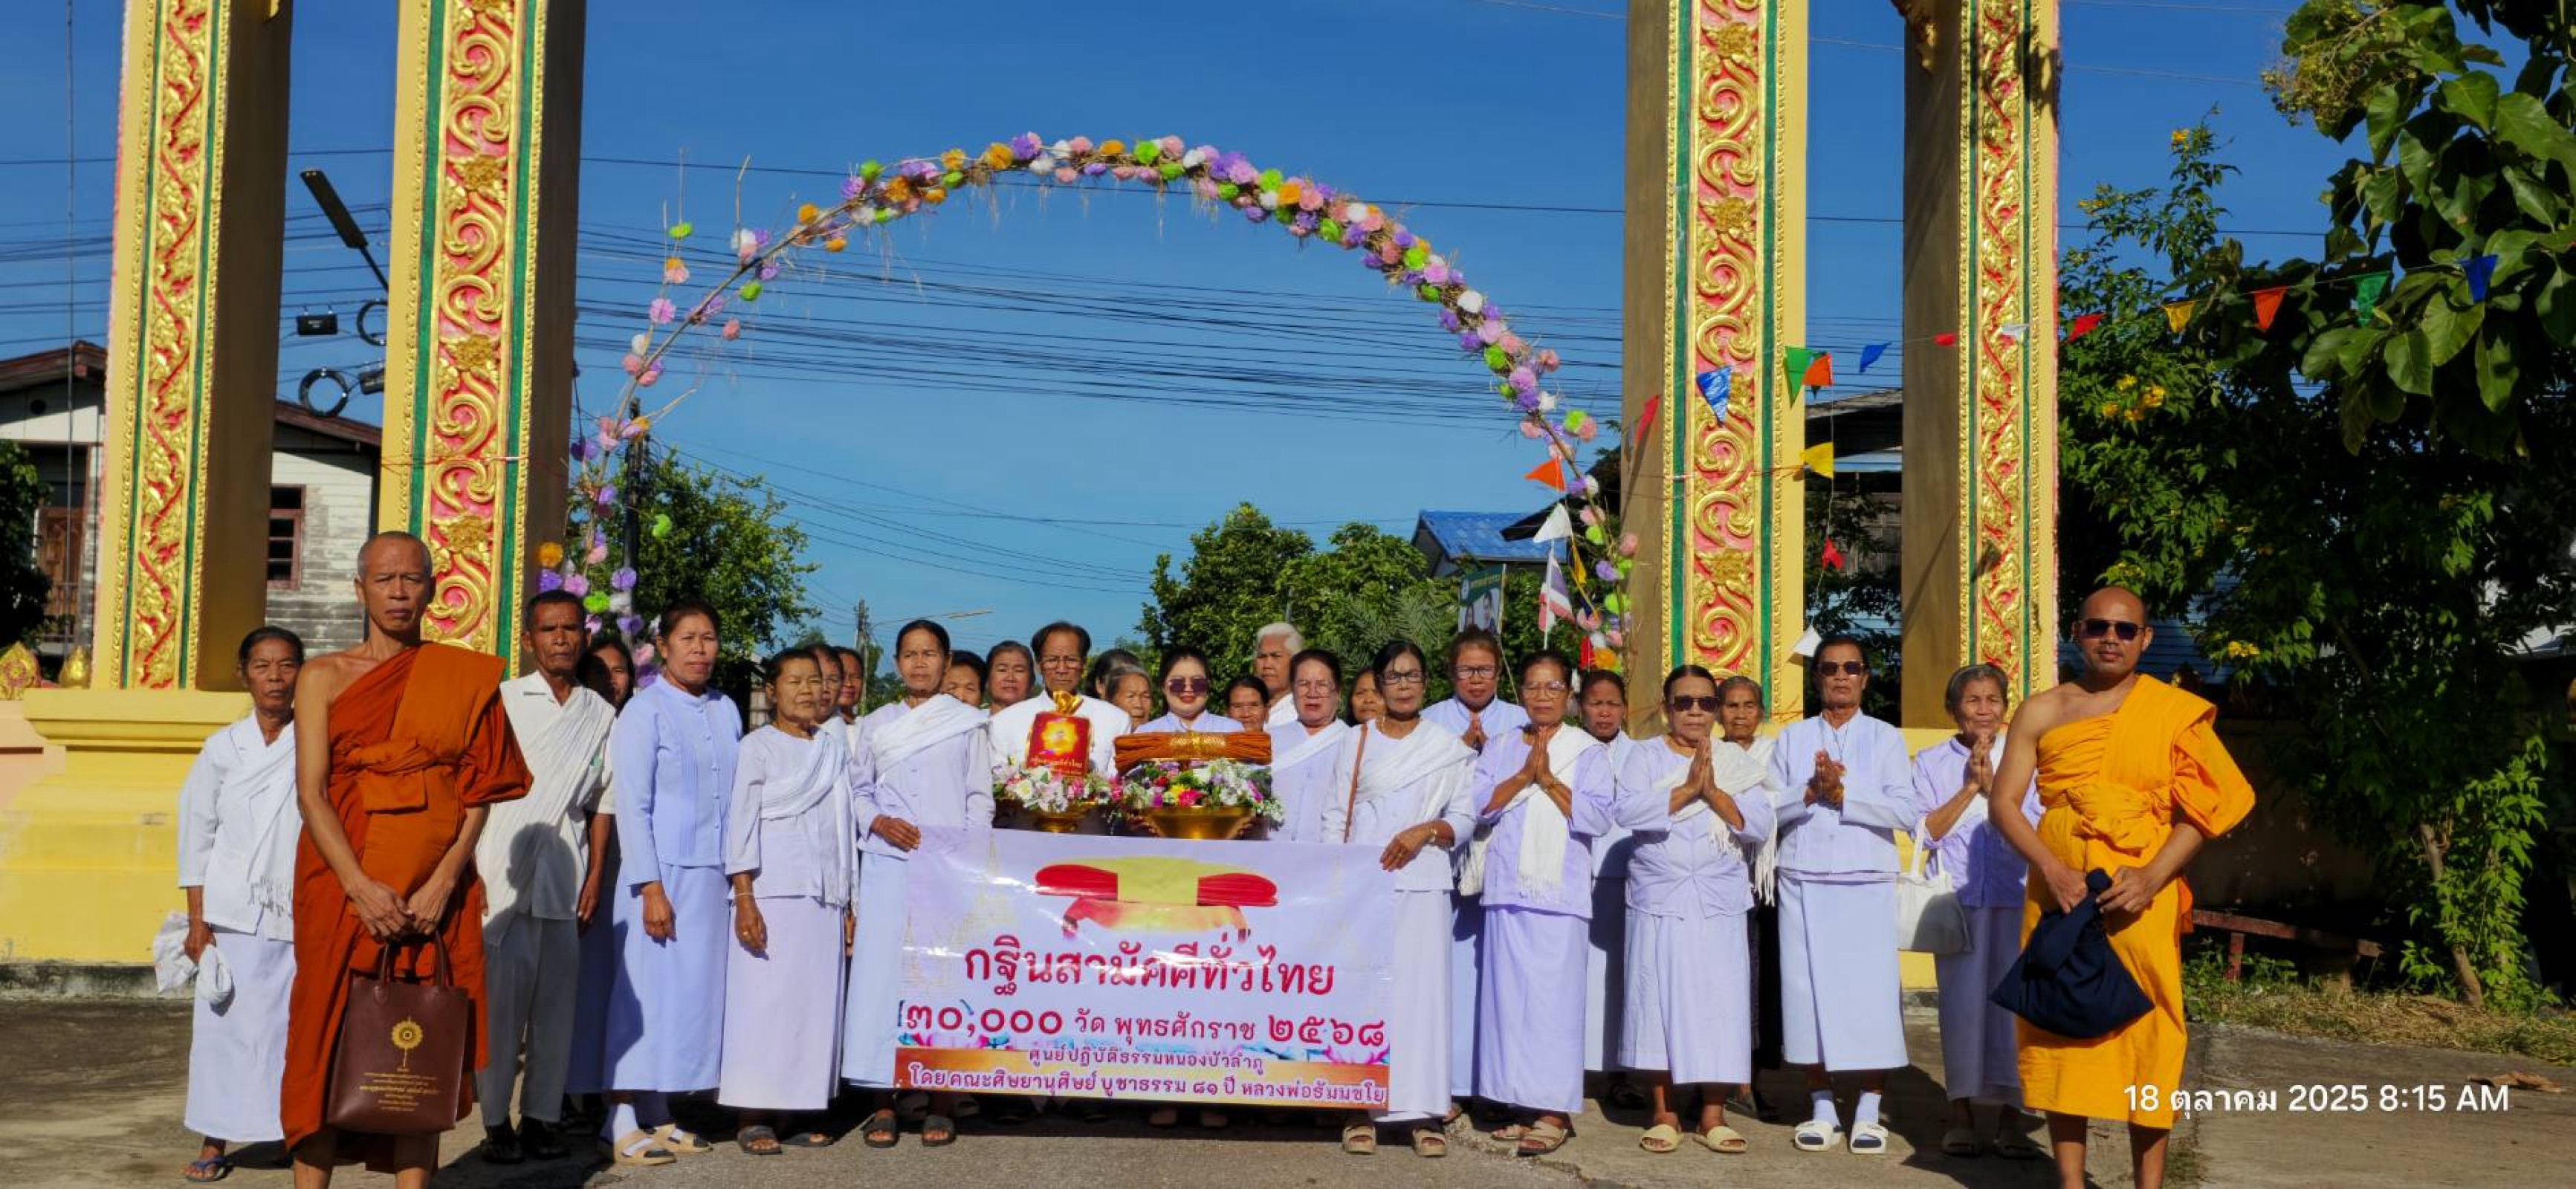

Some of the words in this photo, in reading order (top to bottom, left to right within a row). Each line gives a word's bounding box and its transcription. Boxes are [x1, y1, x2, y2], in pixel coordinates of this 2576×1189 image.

[964, 931, 1334, 996] กฐินสามัคคีทั่วไทย
[906, 1005, 1063, 1037] ๓๐,๐๐๐
[1075, 1008, 1105, 1032] วัด
[1115, 1011, 1255, 1045] พุทธศักราช
[1268, 1014, 1385, 1046] ๒๕๖๘
[1224, 1077, 1235, 1095] ปี
